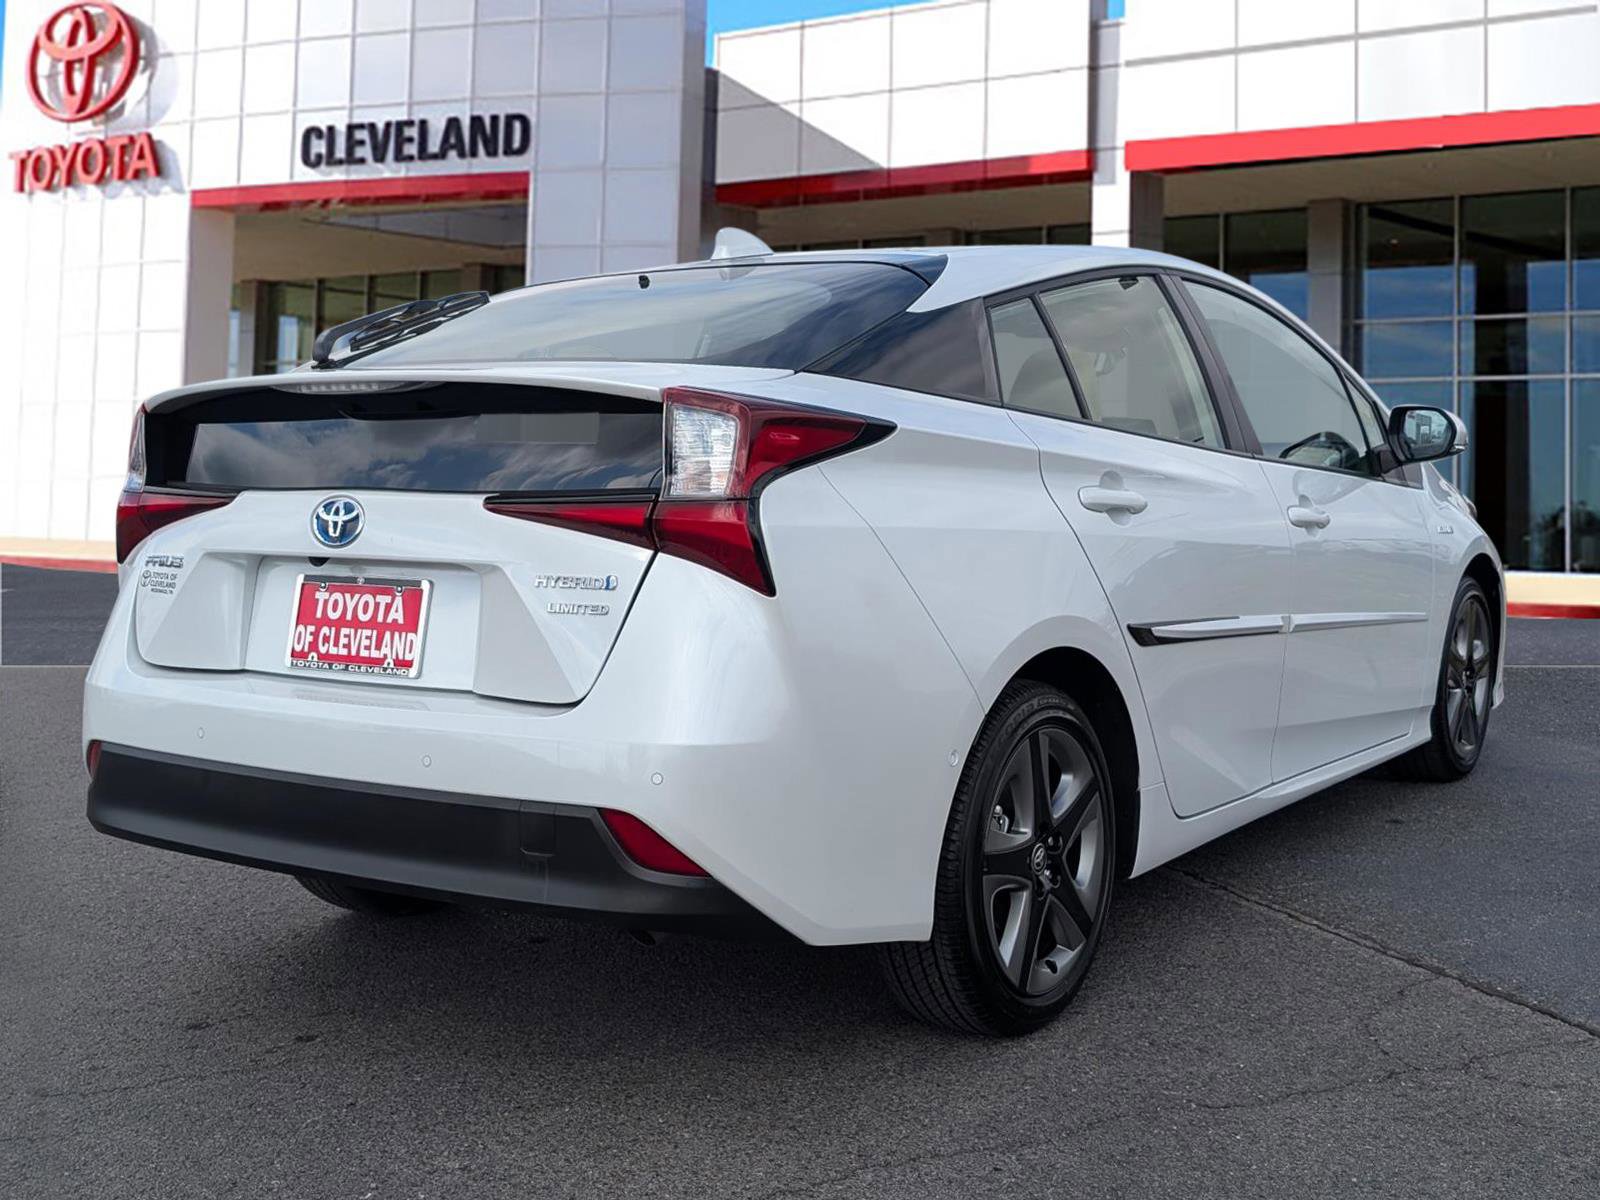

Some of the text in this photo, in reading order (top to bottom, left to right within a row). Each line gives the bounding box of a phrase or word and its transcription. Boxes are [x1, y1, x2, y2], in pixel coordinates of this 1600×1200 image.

[301, 113, 531, 168] CLEVELAND
[9, 132, 161, 193] TOYOTA
[145, 555, 184, 568] PRIUS
[534, 575, 604, 590] HYBRID
[315, 591, 404, 624] TOYOTA
[547, 602, 610, 616] LIMITED
[293, 624, 418, 661] OF CLEVELAND
[291, 660, 329, 669] TOYOTA
[348, 664, 408, 676] CLEVELAND
